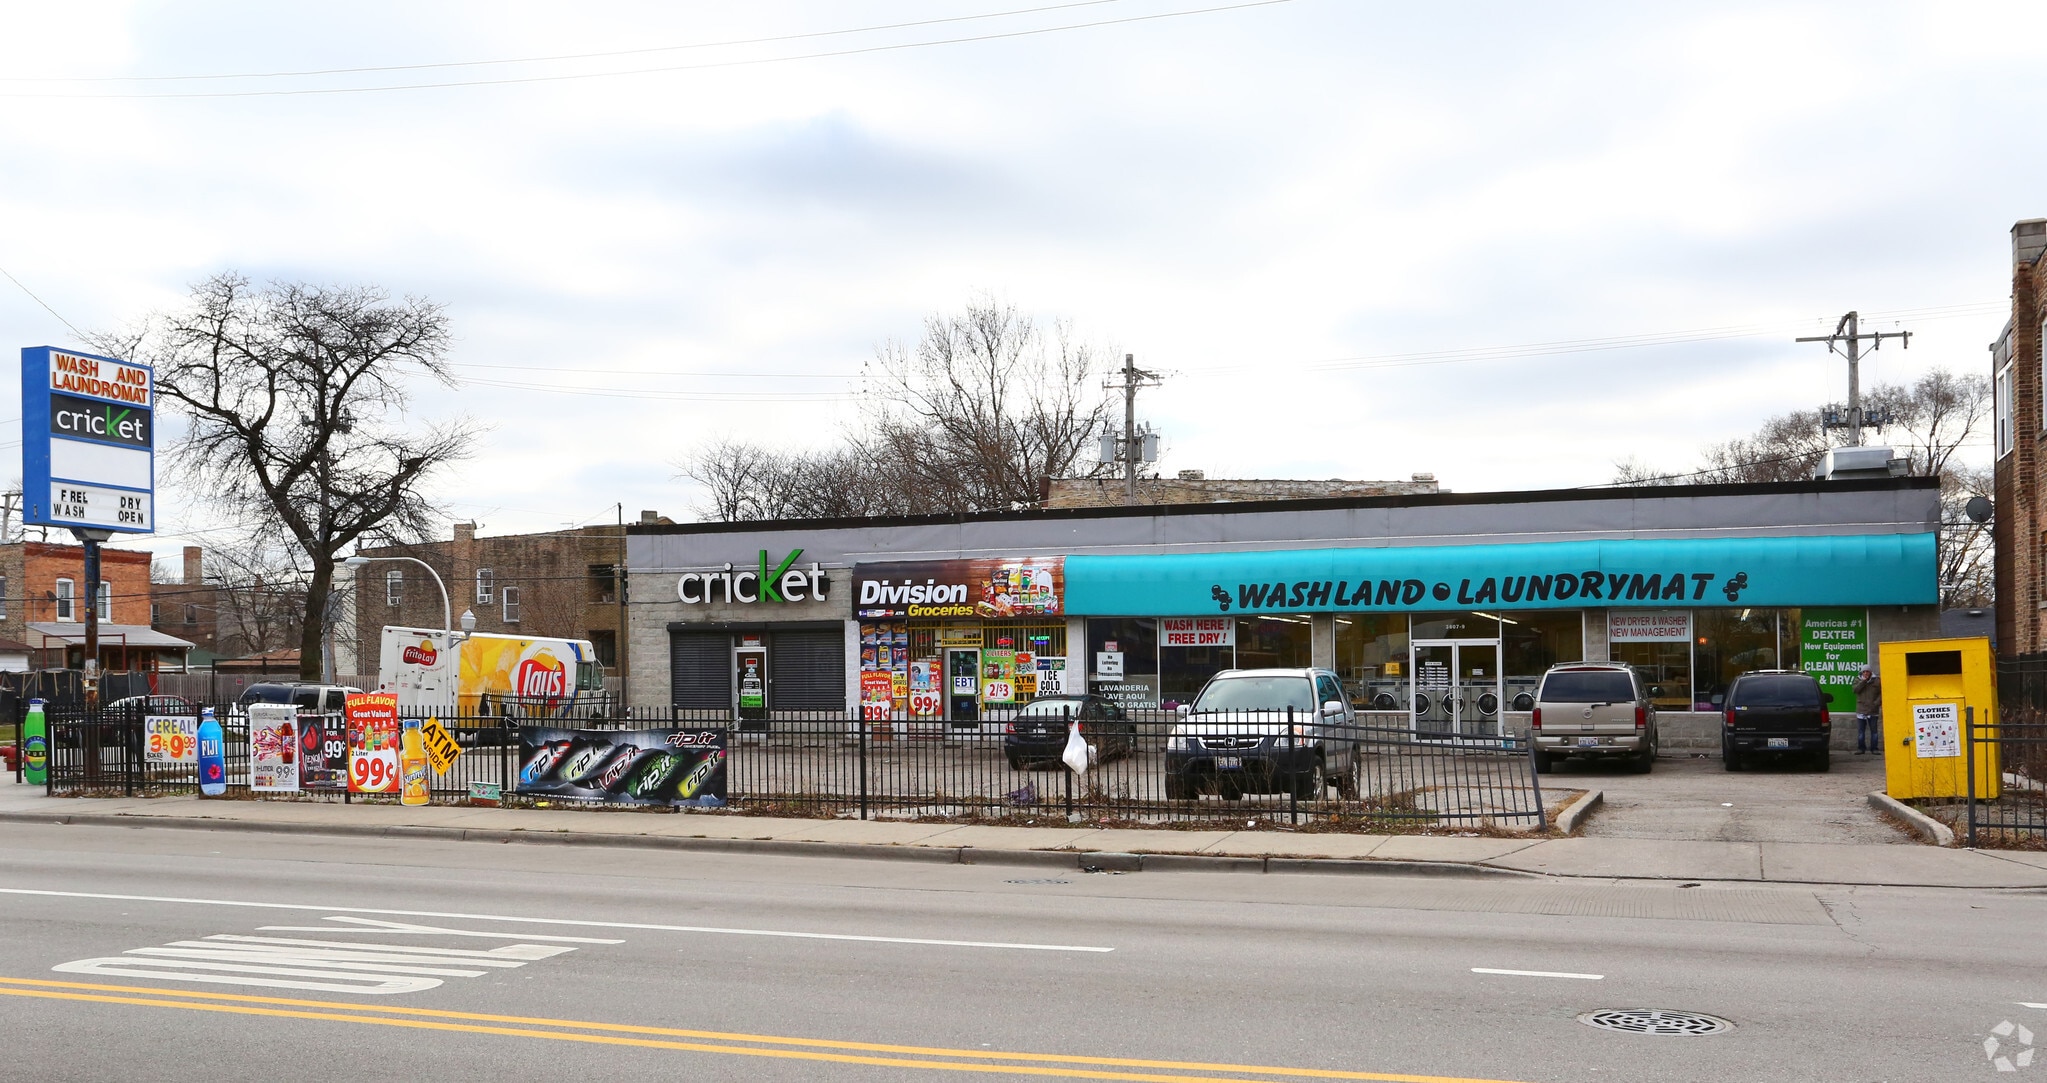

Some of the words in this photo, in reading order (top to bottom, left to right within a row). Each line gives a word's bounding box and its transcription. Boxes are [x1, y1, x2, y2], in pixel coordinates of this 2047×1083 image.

[55, 354, 99, 378] WASH
[116, 367, 146, 386] AND
[52, 372, 148, 403] LAUNDROMAT
[120, 496, 141, 510] DRY
[54, 503, 85, 518] WASH
[118, 510, 144, 524] OPEN
[860, 579, 968, 605] Division
[1238, 579, 1426, 609] WASHLAND
[1457, 570, 1715, 605] LAUNDRYMAT
[908, 603, 974, 617] Groceries
[1164, 619, 1193, 631] WASH
[1611, 617, 1626, 627] NEW
[1627, 616, 1651, 626] DRYER
[1652, 617, 1657, 625] &
[1658, 616, 1687, 626] WASHER
[1805, 619, 1848, 628] Americas
[1850, 619, 1862, 628] #1
[1168, 633, 1196, 644] FREE
[1611, 628, 1629, 638] NEW
[1630, 627, 1686, 638] MANAGEMENT
[1812, 630, 1856, 640] DEXTER
[1804, 642, 1821, 650] New
[1823, 642, 1864, 651] Equipment
[1826, 652, 1840, 660] for
[1804, 661, 1835, 672] CLEAN
[1837, 661, 1864, 672] WASH
[523, 664, 562, 698] Lay's
[955, 677, 974, 687] EBT
[1015, 676, 1035, 684] ATM
[1044, 670, 1057, 680] ICE
[1819, 675, 1827, 685] &
[1041, 680, 1060, 690] COLD
[1099, 684, 1149, 692] LAVANDERIA
[347, 697, 366, 708] FULL
[352, 710, 371, 718] Great
[371, 710, 391, 718] Value!
[147, 718, 194, 734] CEREAL
[150, 734, 162, 753] 3
[422, 723, 458, 764] ATM
[665, 731, 697, 748] rip
[698, 731, 717, 745] it
[201, 740, 218, 756] FIJI
[423, 742, 444, 770] NSIDE
[528, 753, 548, 781] rip
[570, 752, 591, 778] rip
[605, 759, 626, 785] rip
[637, 768, 660, 796] rip
[686, 764, 708, 793] rip
